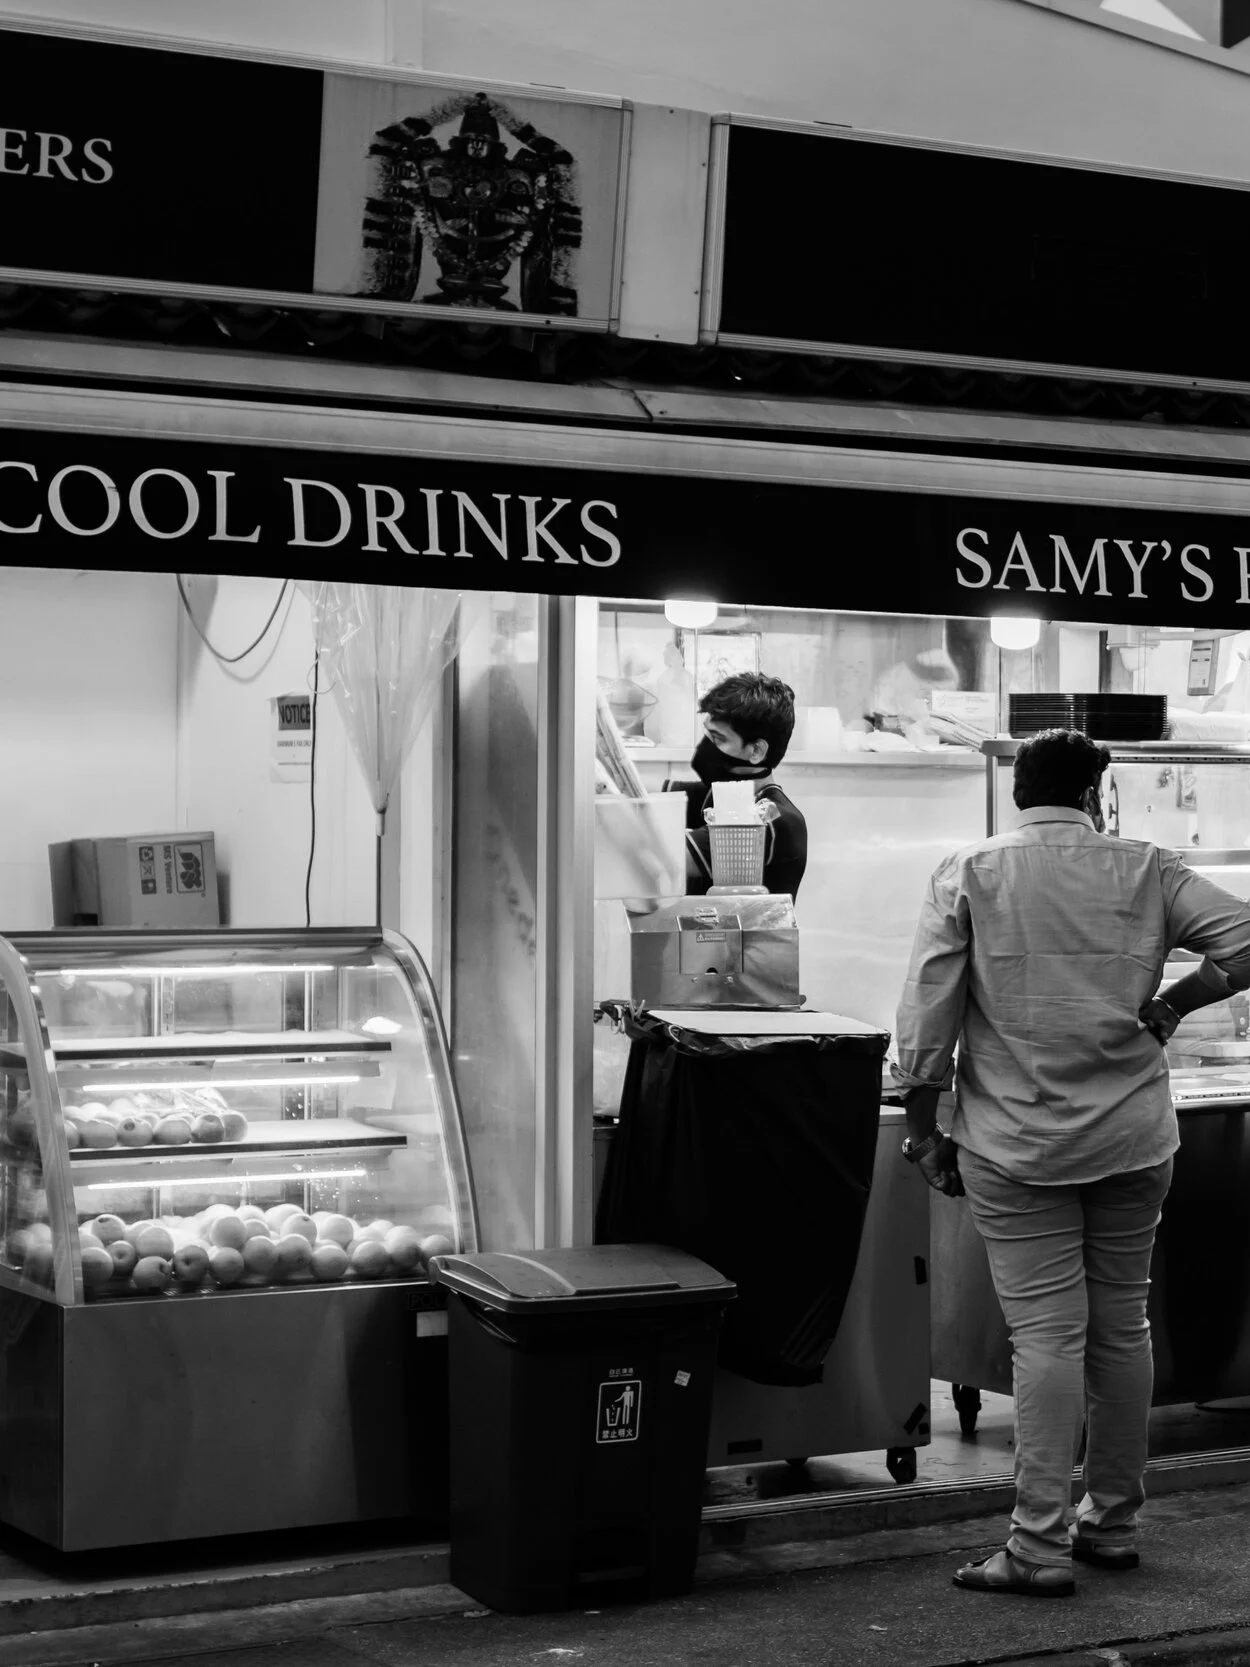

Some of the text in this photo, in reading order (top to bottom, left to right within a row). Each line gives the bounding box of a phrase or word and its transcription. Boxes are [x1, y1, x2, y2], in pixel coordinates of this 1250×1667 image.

[0, 460, 622, 568] COOL DRINKS
[956, 527, 1215, 603] SAMY'S
[278, 703, 311, 725] NOTICE
